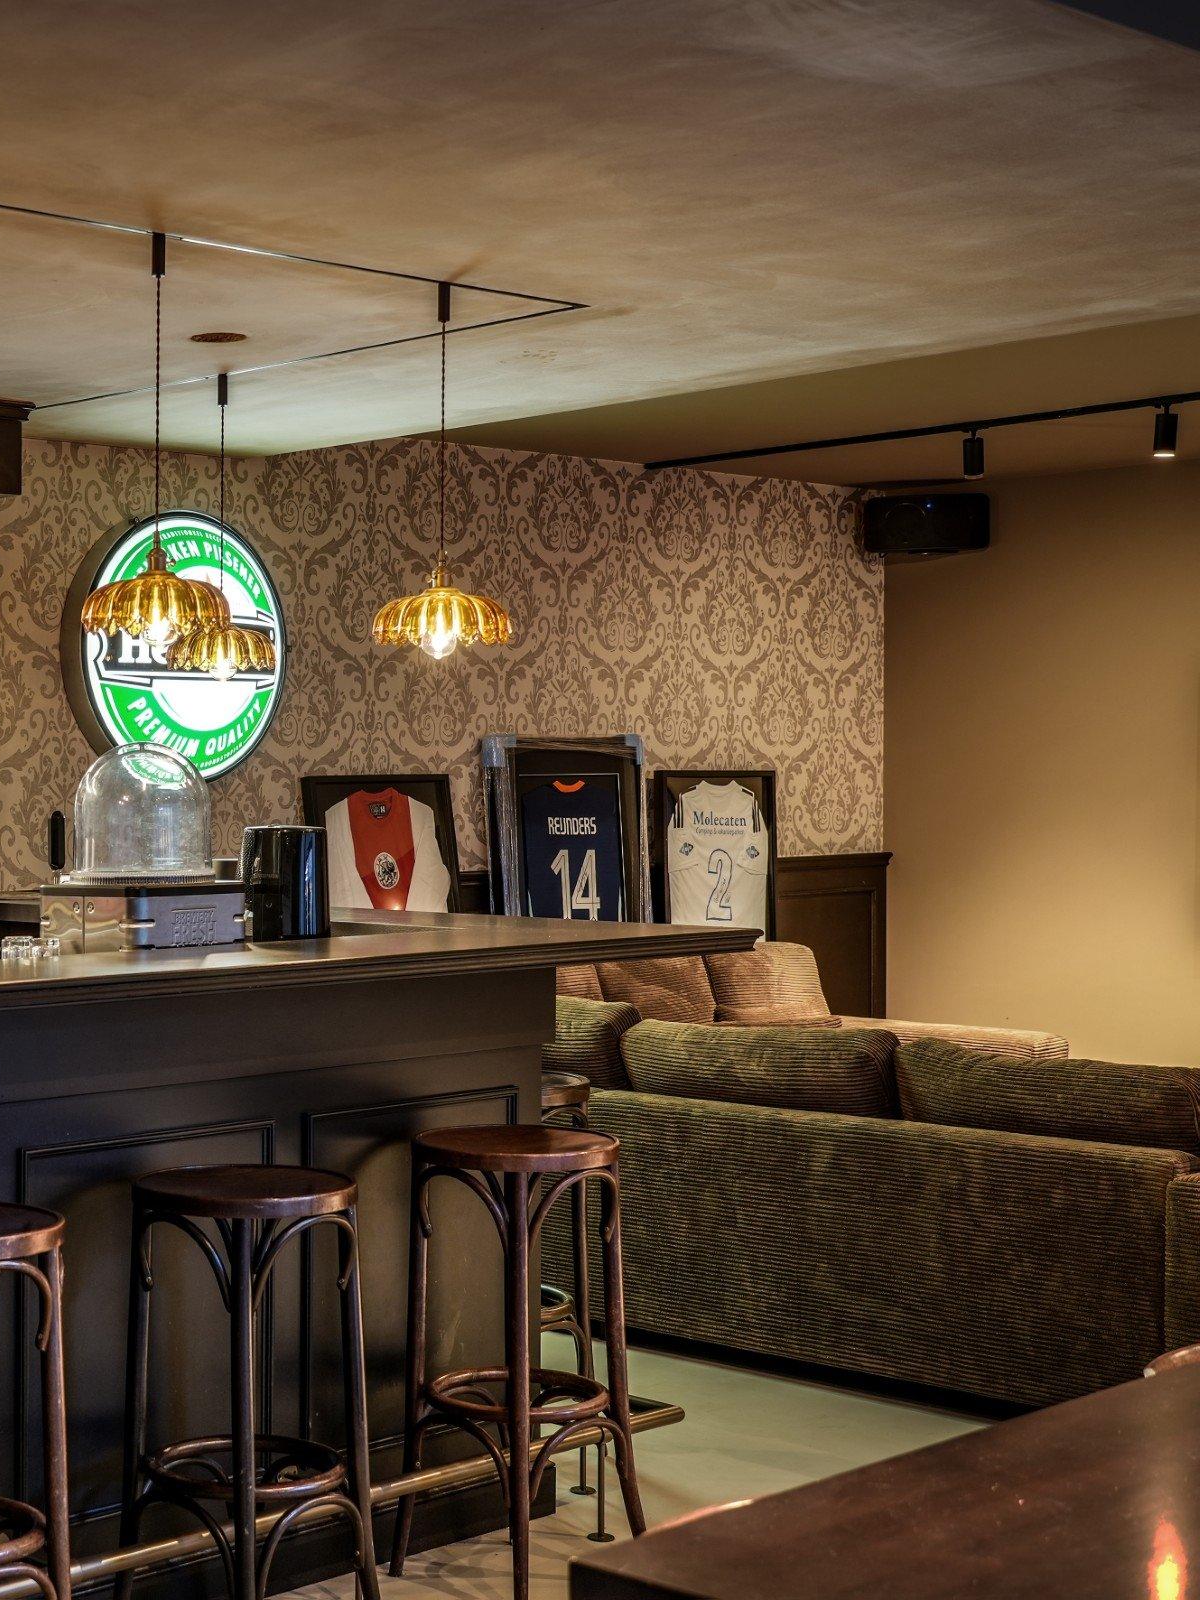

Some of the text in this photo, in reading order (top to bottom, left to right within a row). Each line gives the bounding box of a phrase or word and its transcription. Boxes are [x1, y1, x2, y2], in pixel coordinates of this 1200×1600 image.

[203, 541, 261, 599] PILSENER
[126, 697, 200, 757] PREMIUM
[205, 698, 261, 756] QUALITY
[693, 811, 746, 826] Molecaten
[550, 849, 601, 921] 14
[706, 848, 733, 921] 2
